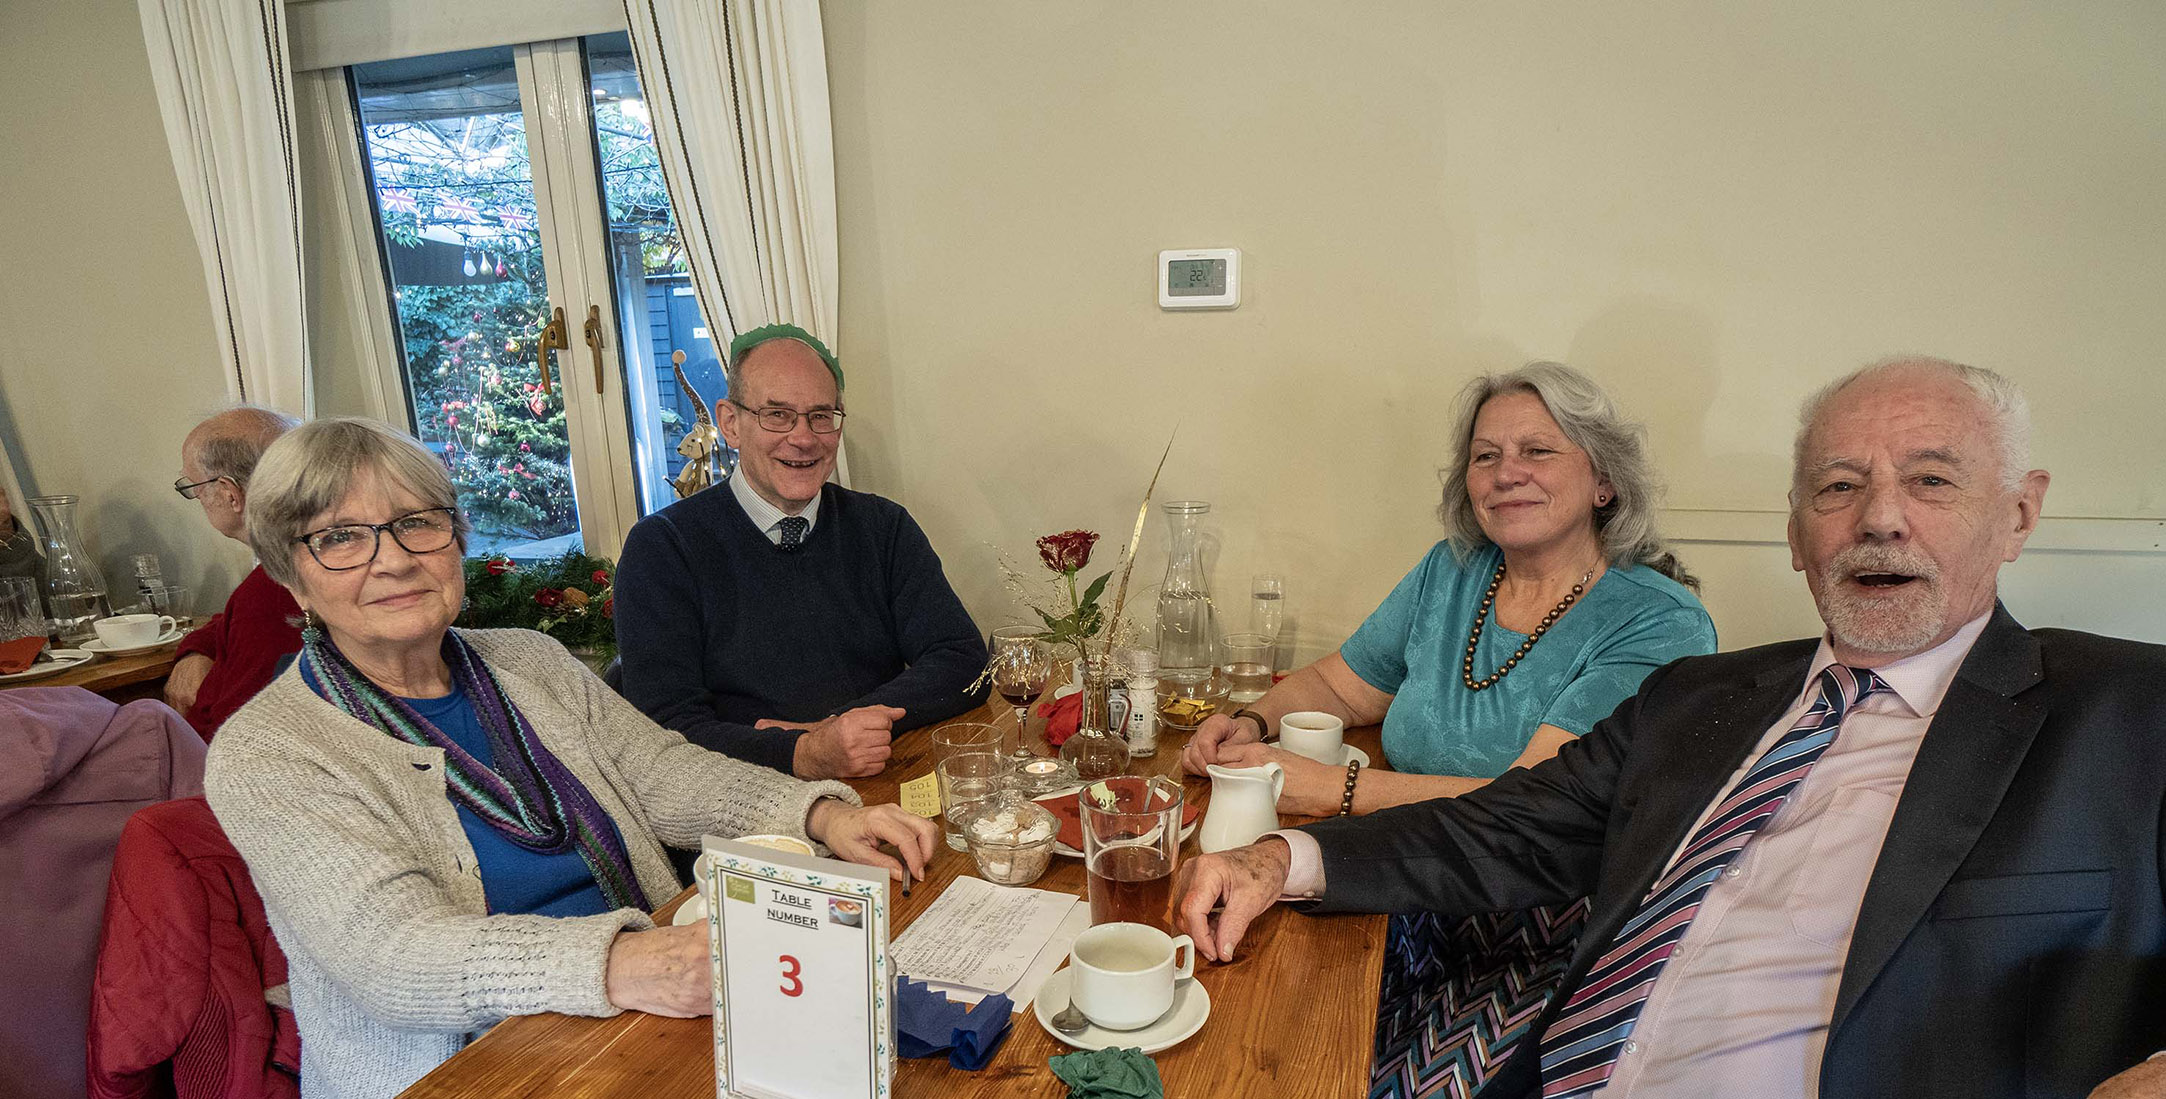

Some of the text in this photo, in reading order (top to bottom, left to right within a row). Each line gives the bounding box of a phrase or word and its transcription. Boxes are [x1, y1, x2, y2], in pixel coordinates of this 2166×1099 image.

[772, 889, 812, 908] TABLE
[767, 908, 819, 928] NUMBER
[779, 954, 804, 997] 3
